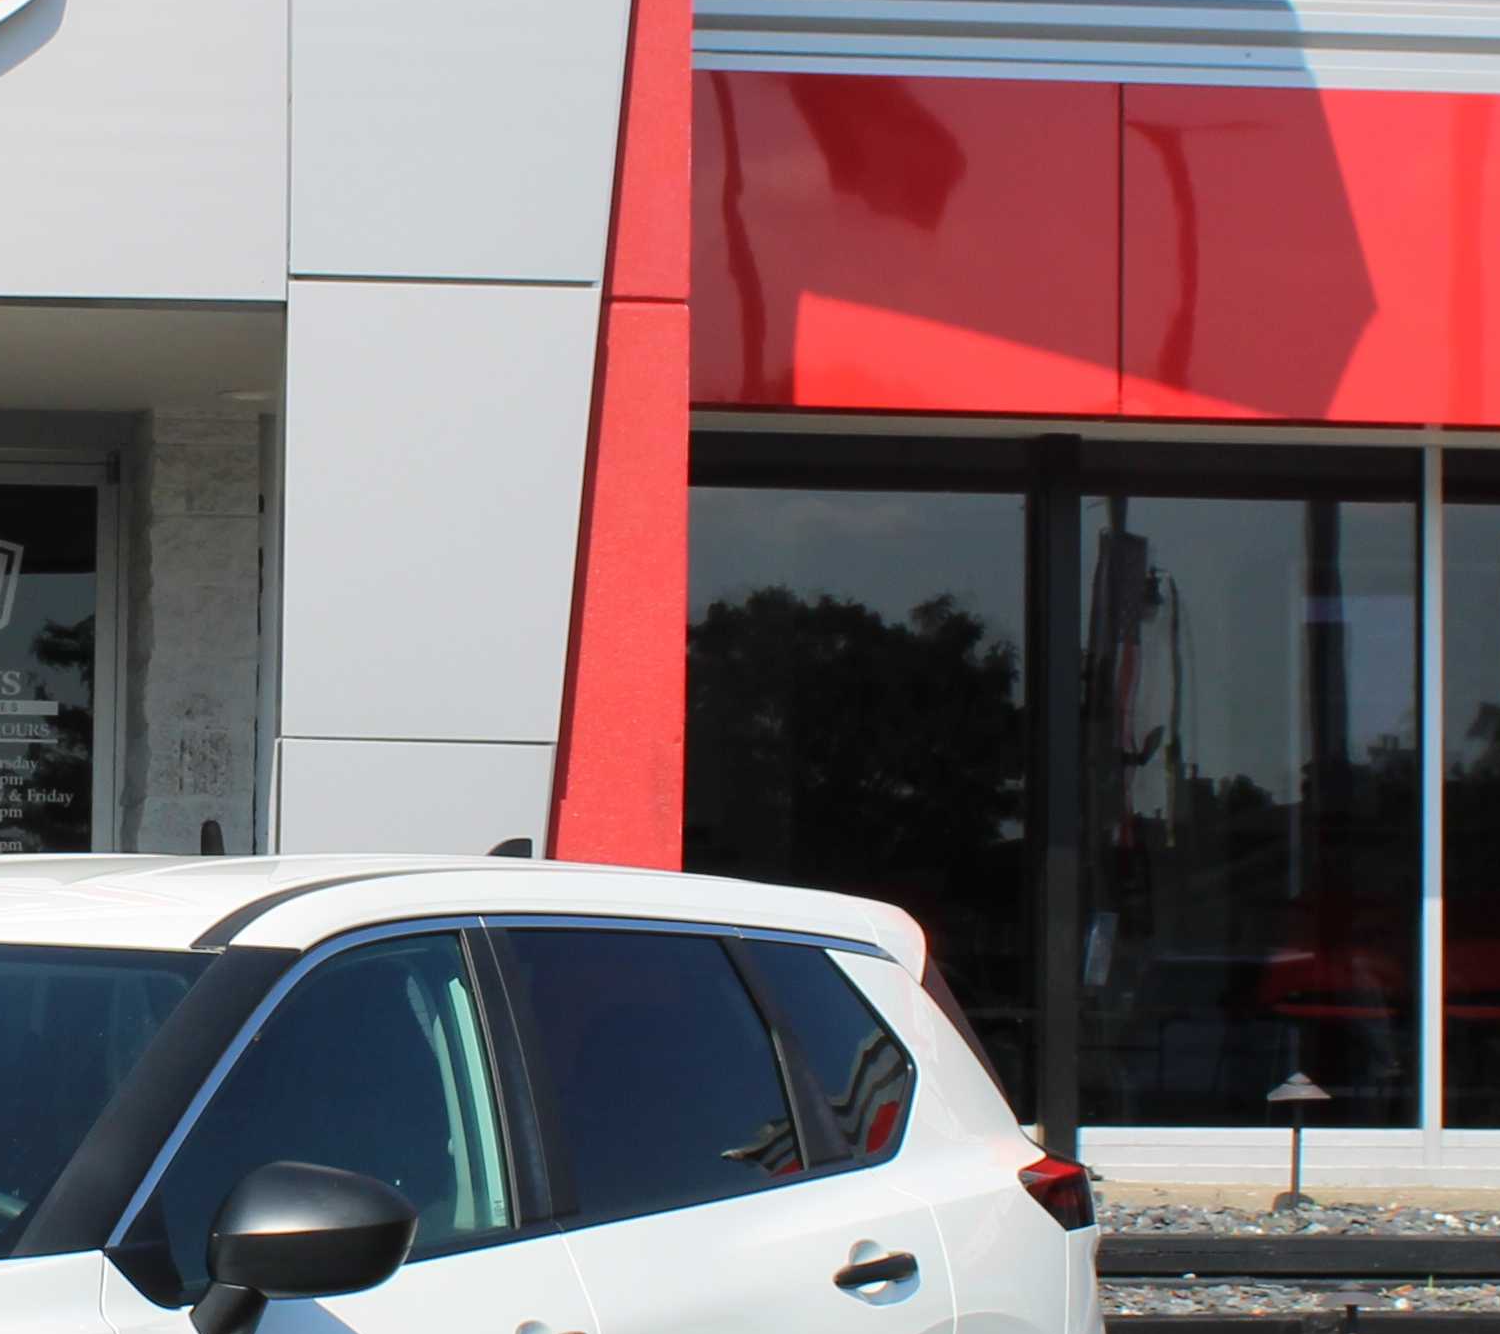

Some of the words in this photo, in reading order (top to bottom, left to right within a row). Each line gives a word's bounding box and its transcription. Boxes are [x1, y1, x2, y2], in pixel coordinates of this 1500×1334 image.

[0, 775, 24, 789] pm
[9, 789, 23, 802] &
[27, 789, 75, 807] Friday
[0, 808, 24, 822] pm
